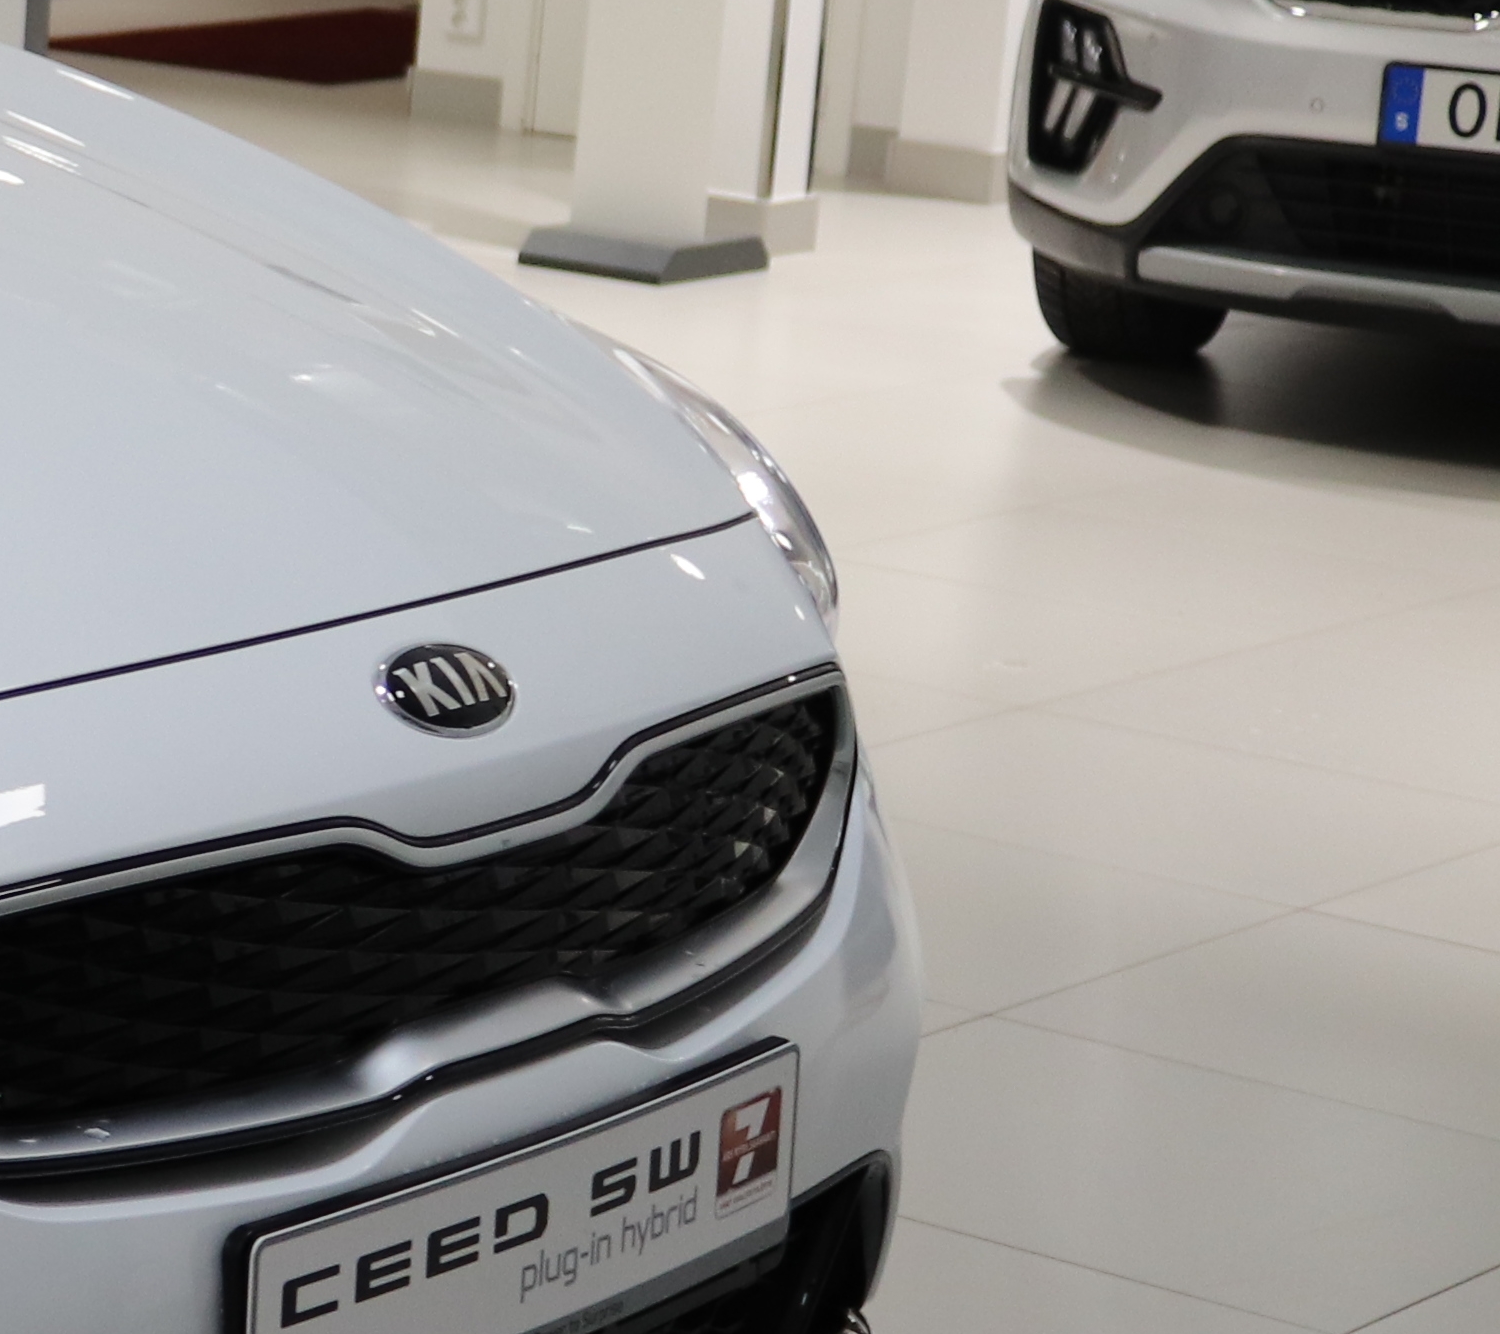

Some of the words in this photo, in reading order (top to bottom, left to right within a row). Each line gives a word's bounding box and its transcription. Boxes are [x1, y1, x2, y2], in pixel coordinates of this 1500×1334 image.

[1448, 82, 1500, 141] O
[392, 652, 508, 717] KIA
[280, 1192, 550, 1329] CEED
[589, 1130, 702, 1218] SW
[519, 1233, 612, 1303] plug-in
[620, 1186, 699, 1255] hybrid
